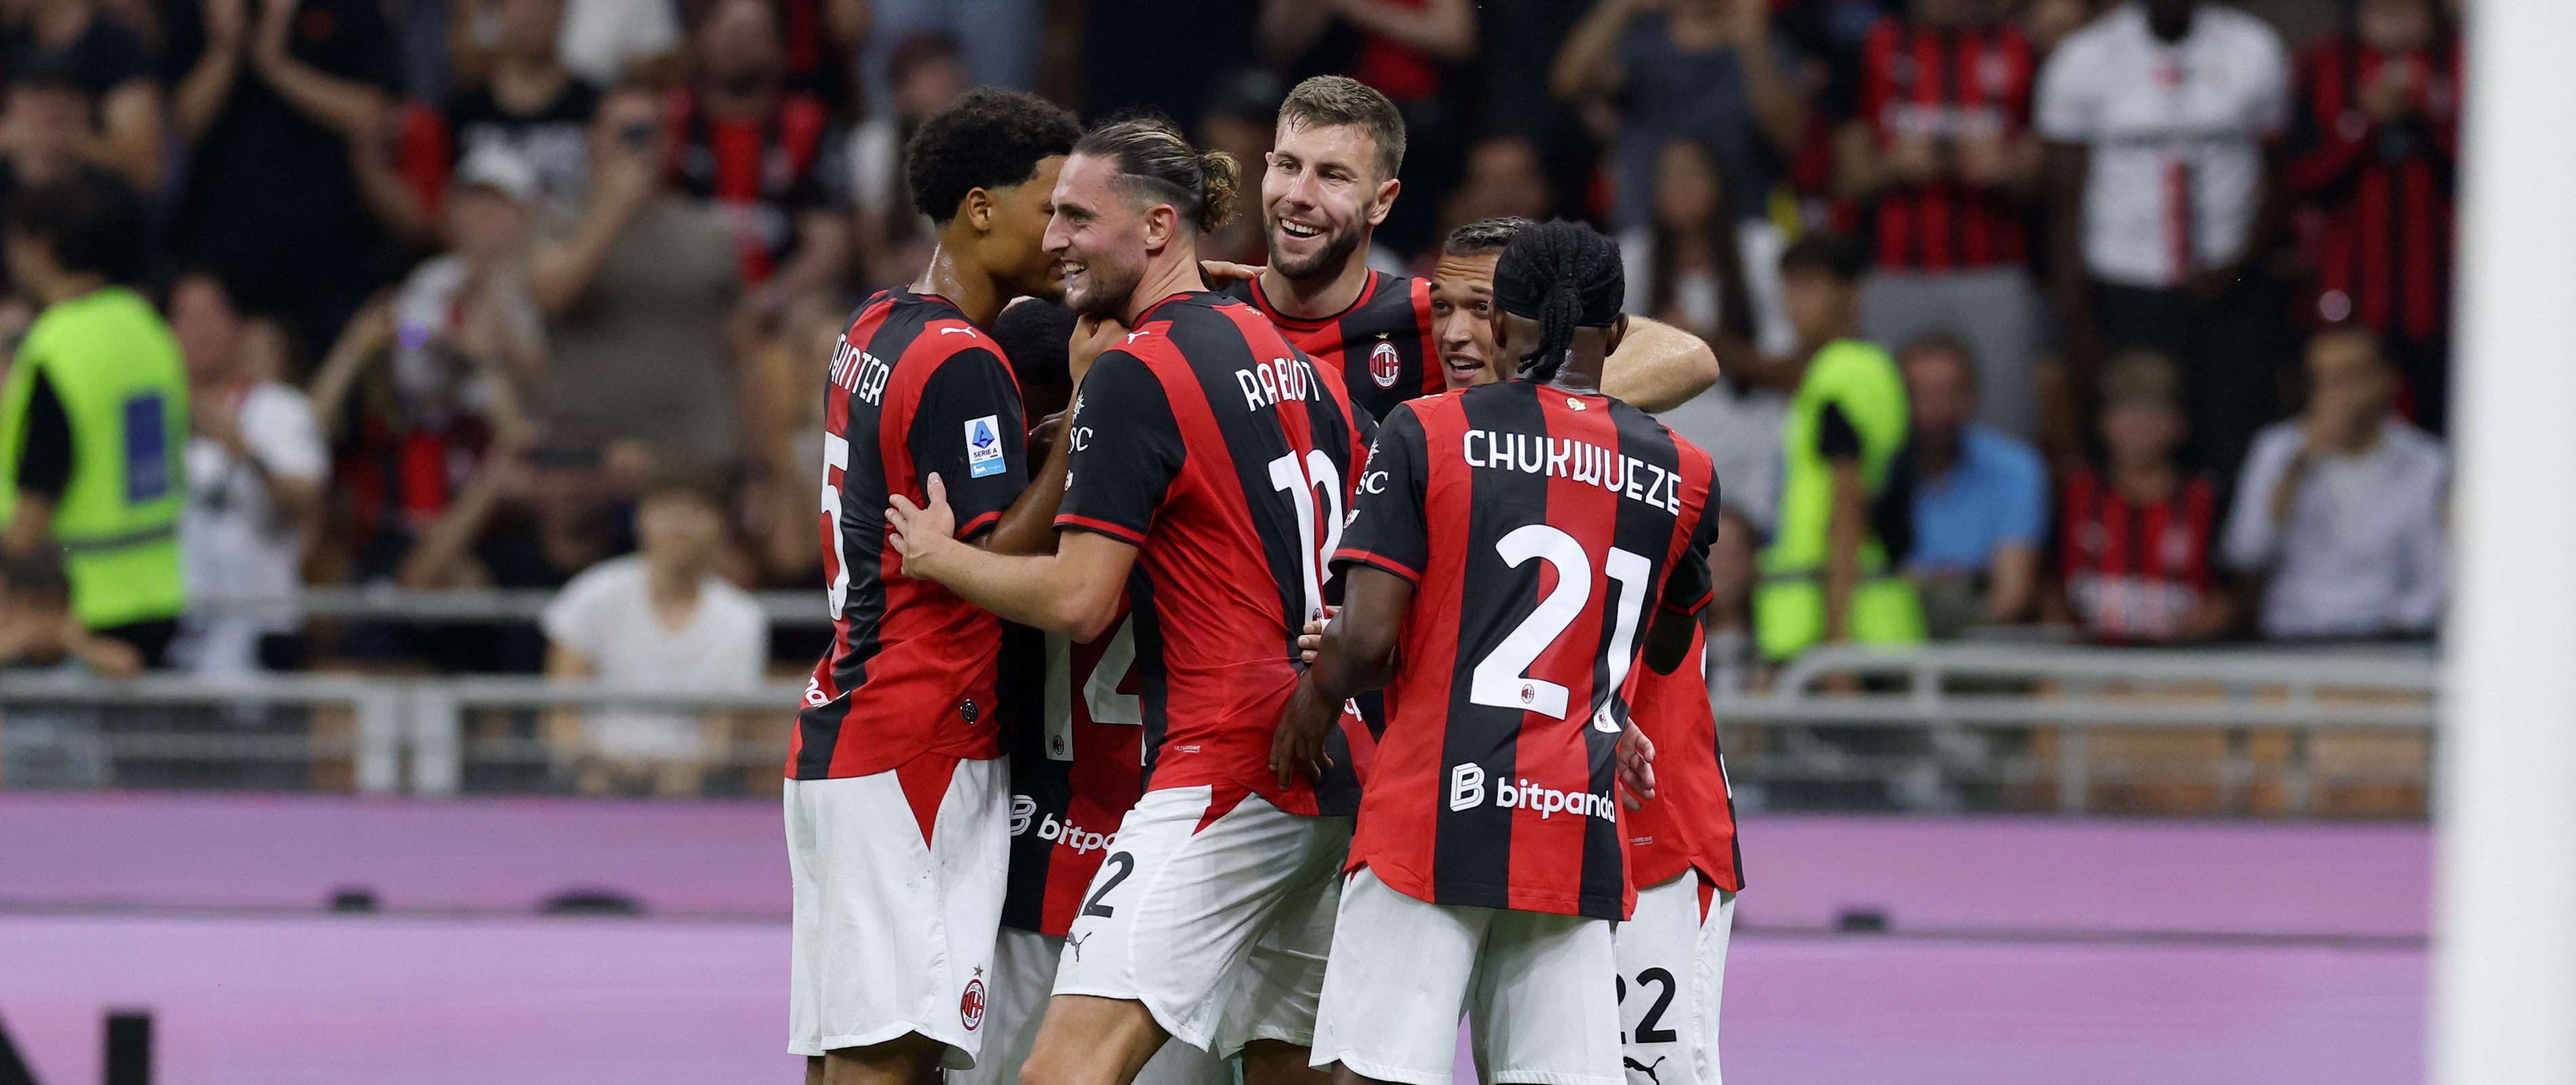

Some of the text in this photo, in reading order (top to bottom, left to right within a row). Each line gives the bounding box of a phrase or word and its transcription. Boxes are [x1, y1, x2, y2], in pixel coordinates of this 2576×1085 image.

[1377, 344, 1394, 353] ACM
[1234, 357, 1321, 412] RABIOT
[973, 448, 992, 458] SERIE
[1463, 429, 1682, 517] CHUKWUEZE
[1470, 524, 1652, 733] 21
[1496, 776, 1615, 824] bitpanda
[1074, 850, 1135, 919] 2
[1615, 967, 1677, 1044] 2
